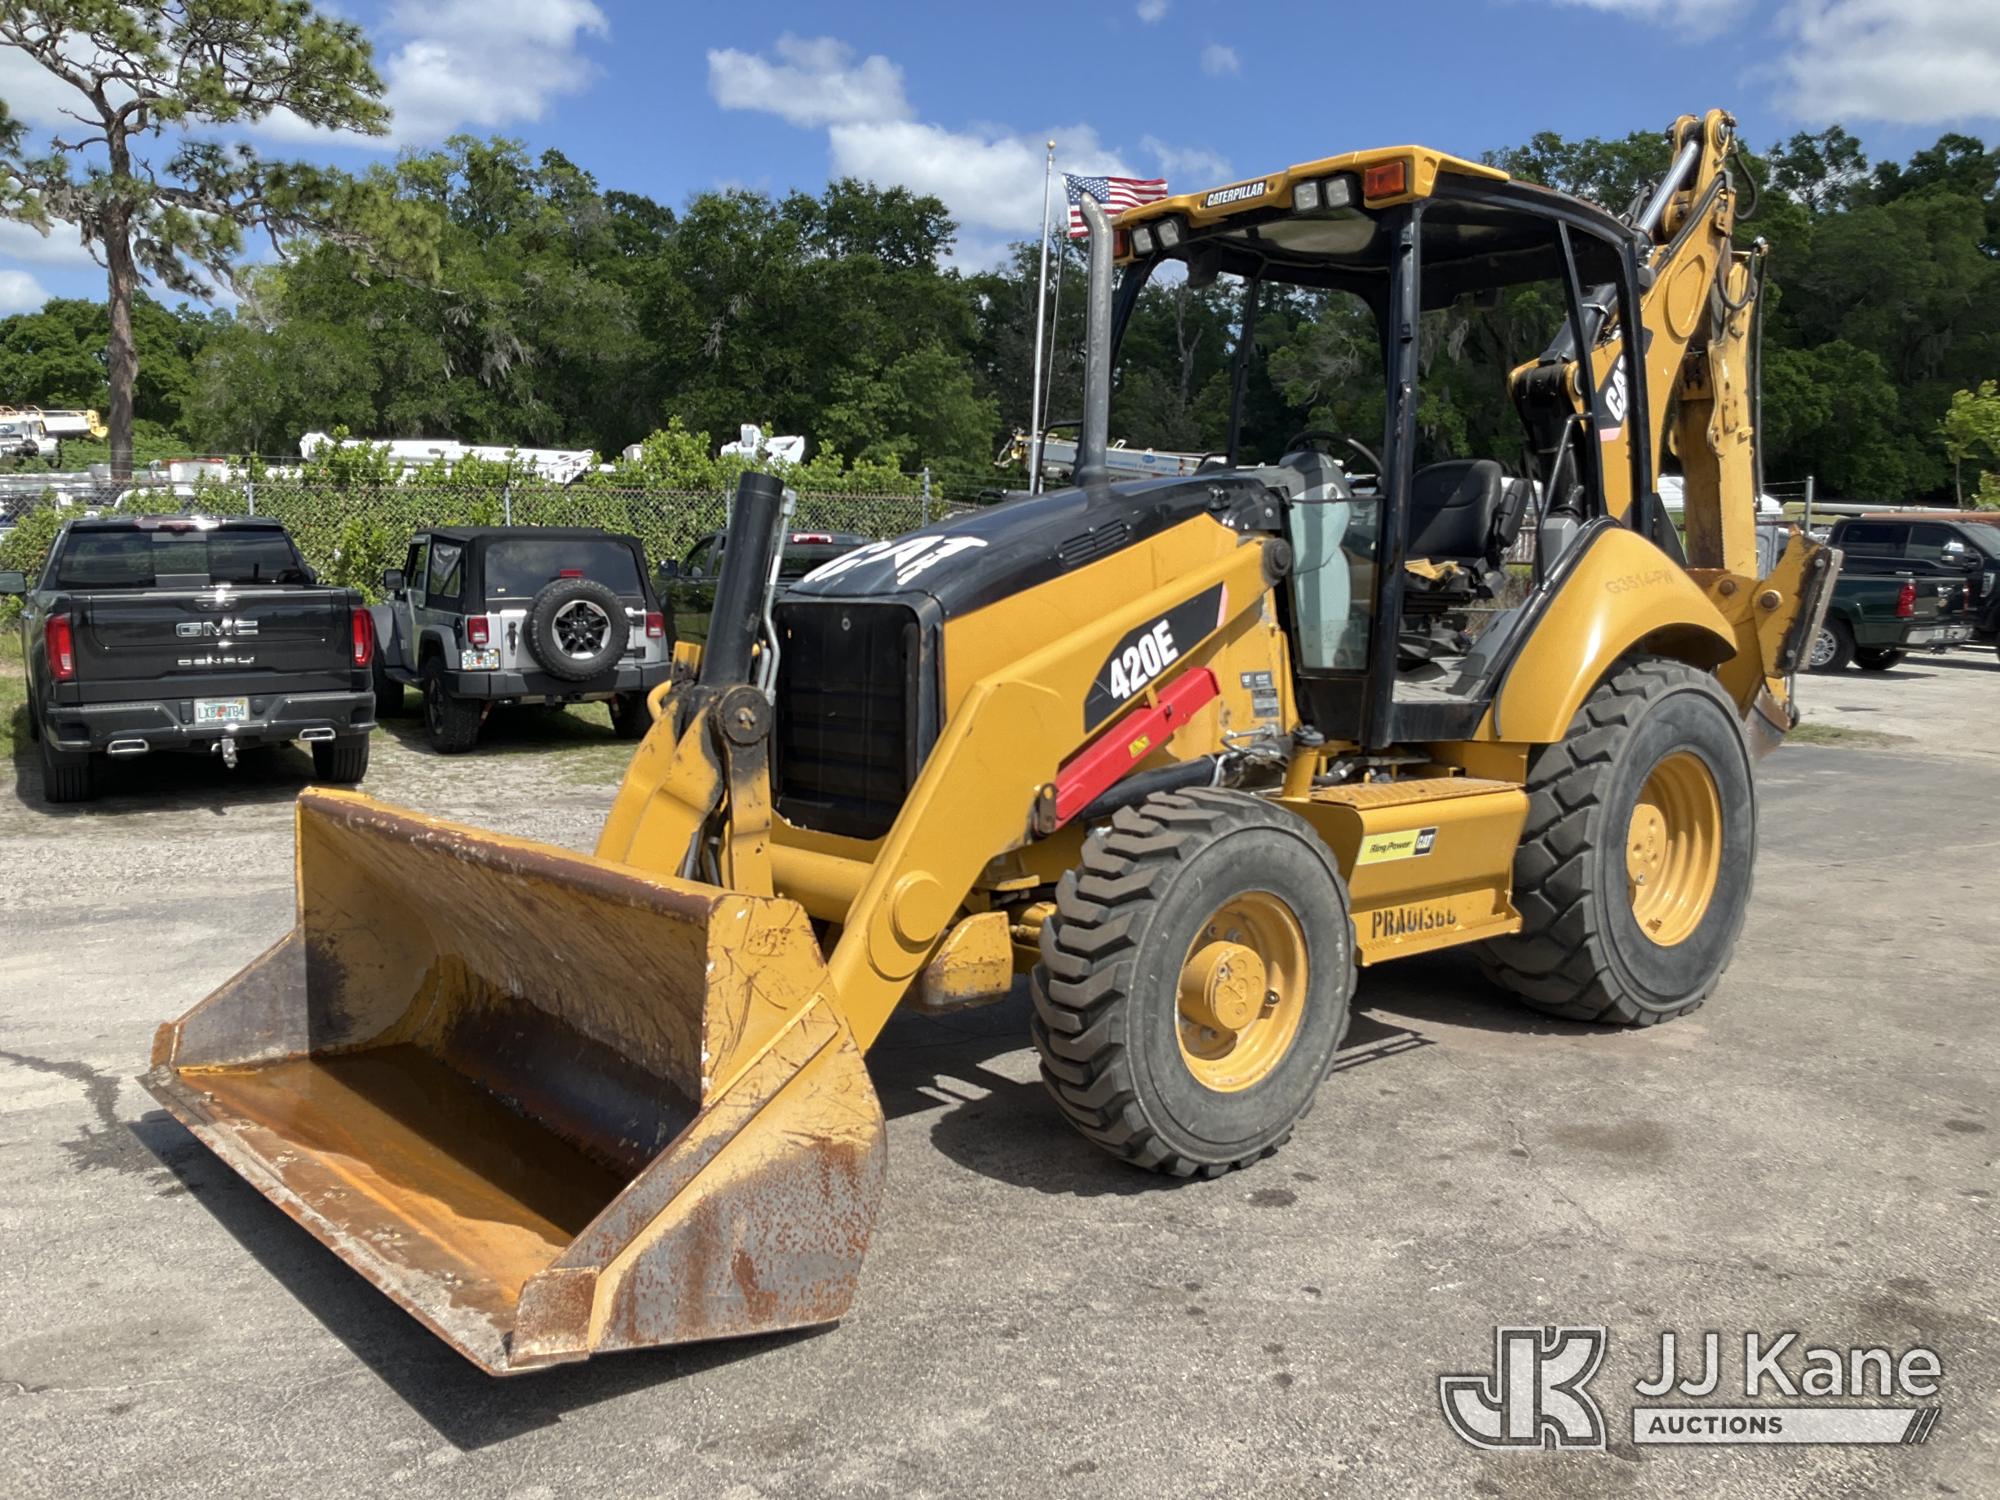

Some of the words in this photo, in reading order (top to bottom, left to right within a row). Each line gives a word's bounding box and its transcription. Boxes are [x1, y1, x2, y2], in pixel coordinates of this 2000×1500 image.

[1206, 182, 1265, 207] CATERPILLAR
[1605, 354, 1628, 421] CA
[803, 535, 988, 585] CAT
[176, 618, 258, 637] GMC
[1110, 618, 1179, 699] 420E
